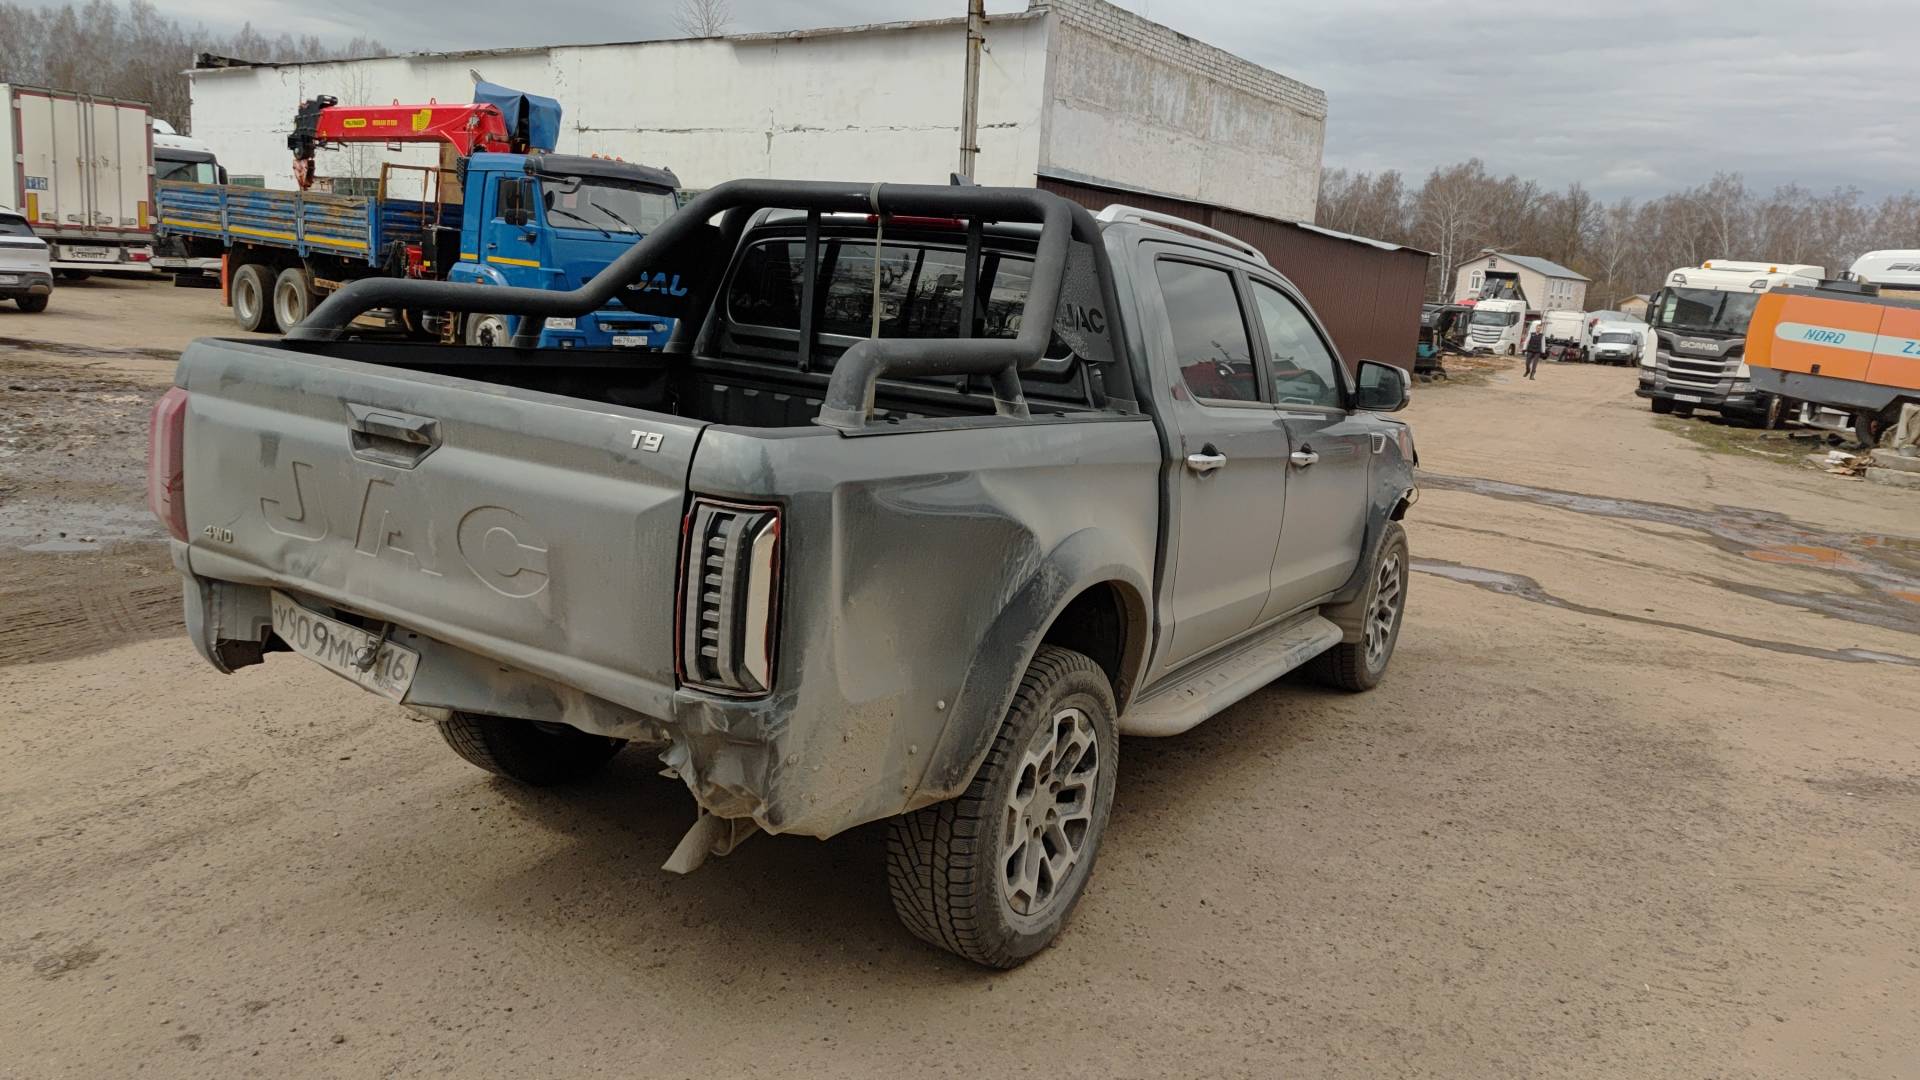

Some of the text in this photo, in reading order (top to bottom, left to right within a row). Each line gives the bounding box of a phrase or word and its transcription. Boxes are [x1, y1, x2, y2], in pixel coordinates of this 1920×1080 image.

[26, 177, 48, 190] TIR
[1056, 303, 1105, 334] JAC
[1679, 341, 1720, 352] SCANIA
[1804, 328, 1847, 345] NORD
[631, 429, 665, 453] T9
[203, 524, 234, 545] 4WD
[260, 460, 551, 599] JAC
